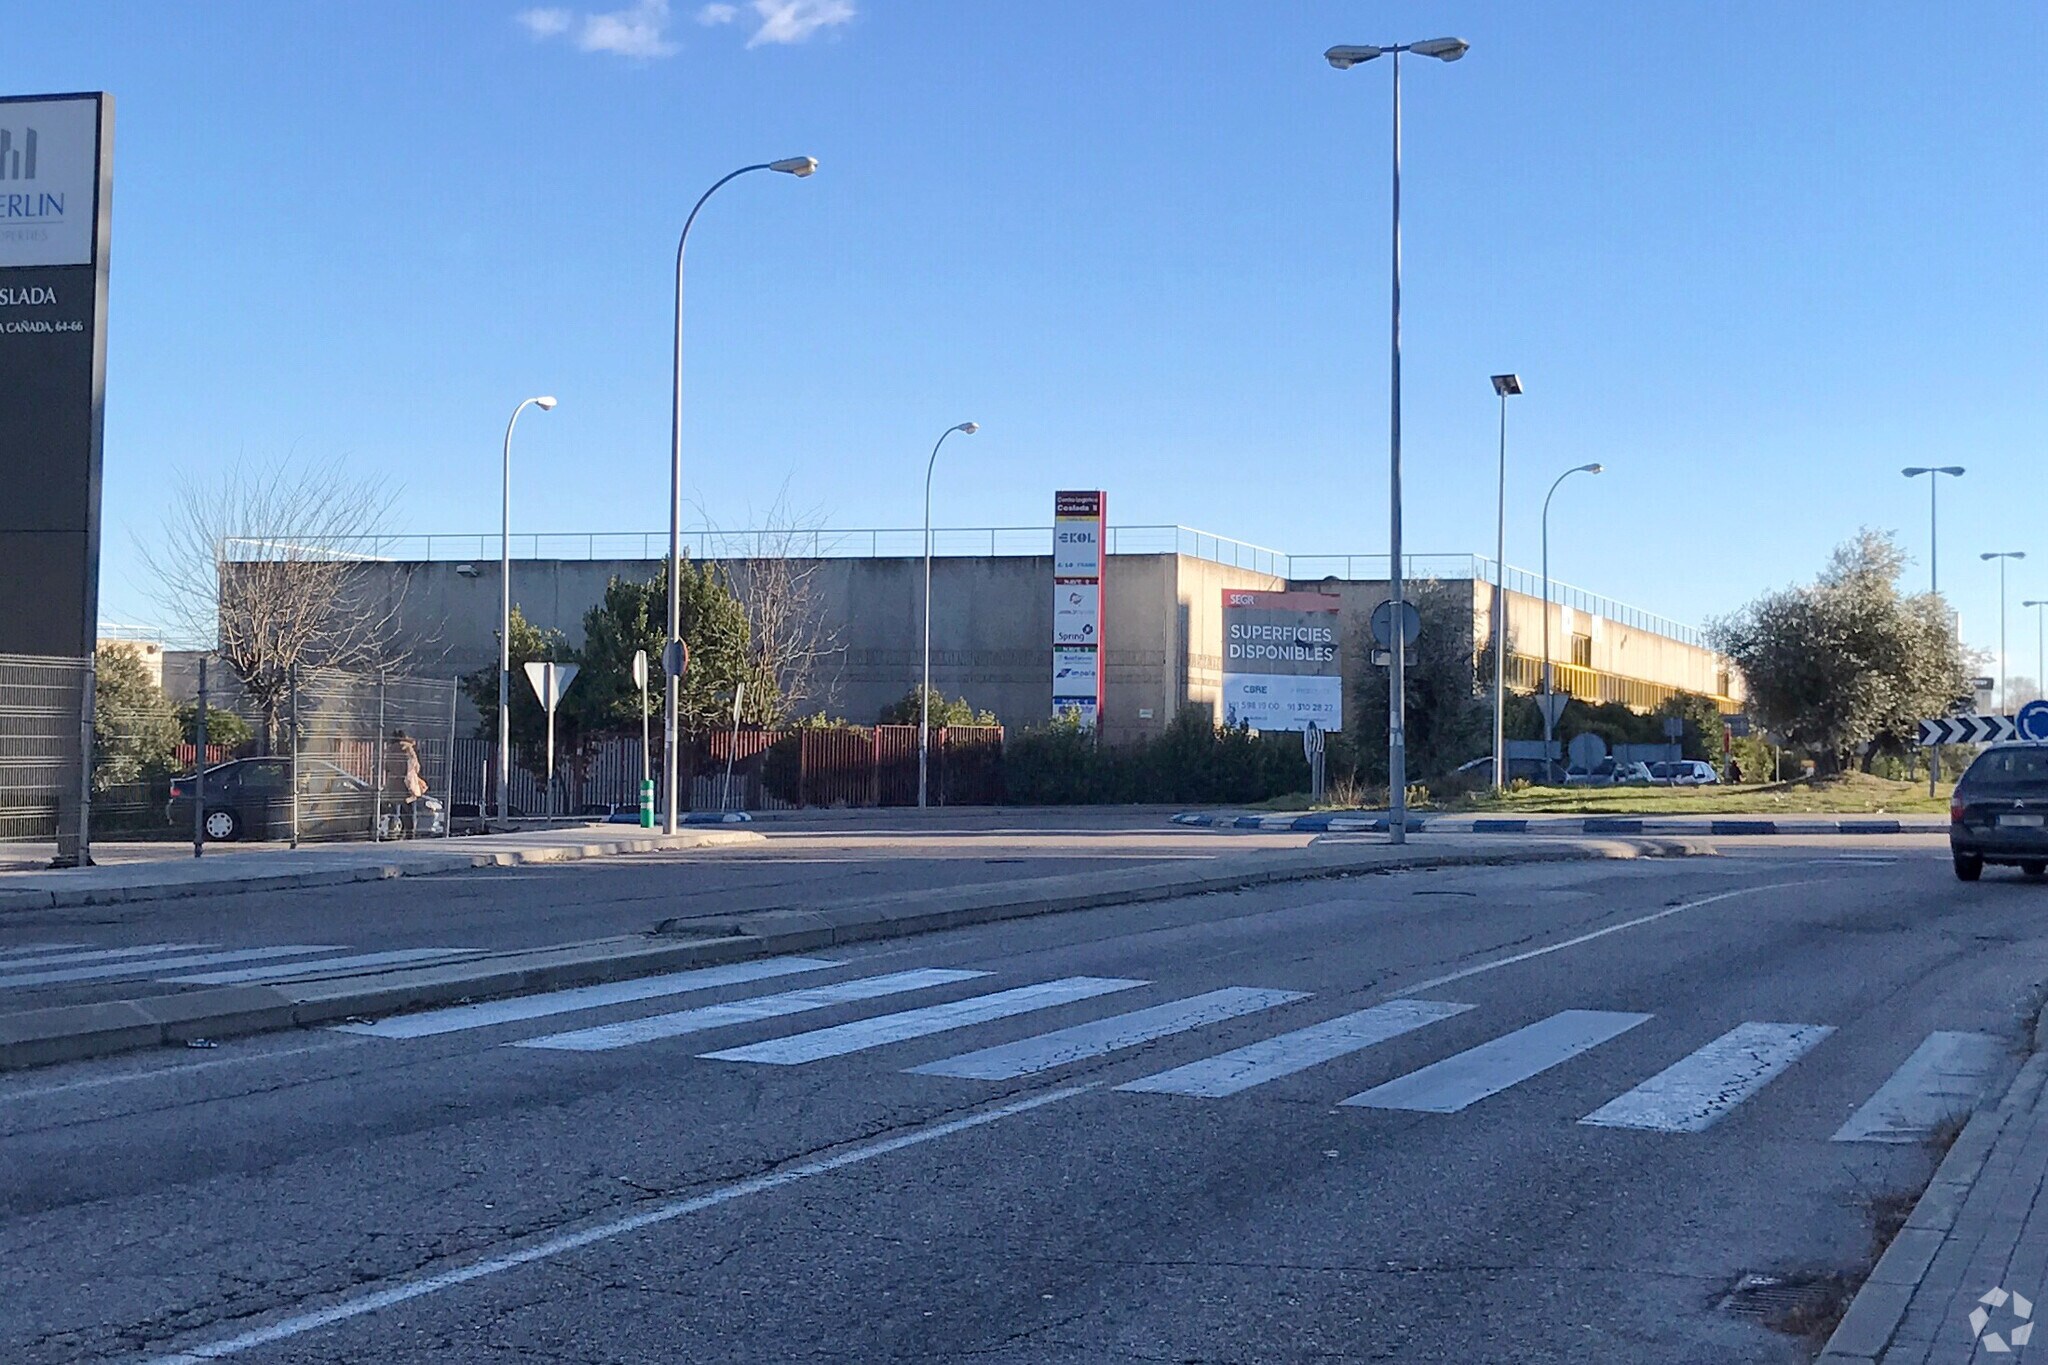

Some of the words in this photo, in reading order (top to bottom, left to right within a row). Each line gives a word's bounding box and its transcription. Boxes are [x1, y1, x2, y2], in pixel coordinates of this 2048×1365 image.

[1058, 632, 1085, 642] Spring
[1230, 624, 1332, 642] SUPERFICIES
[1229, 643, 1334, 662] DISPONIBLES
